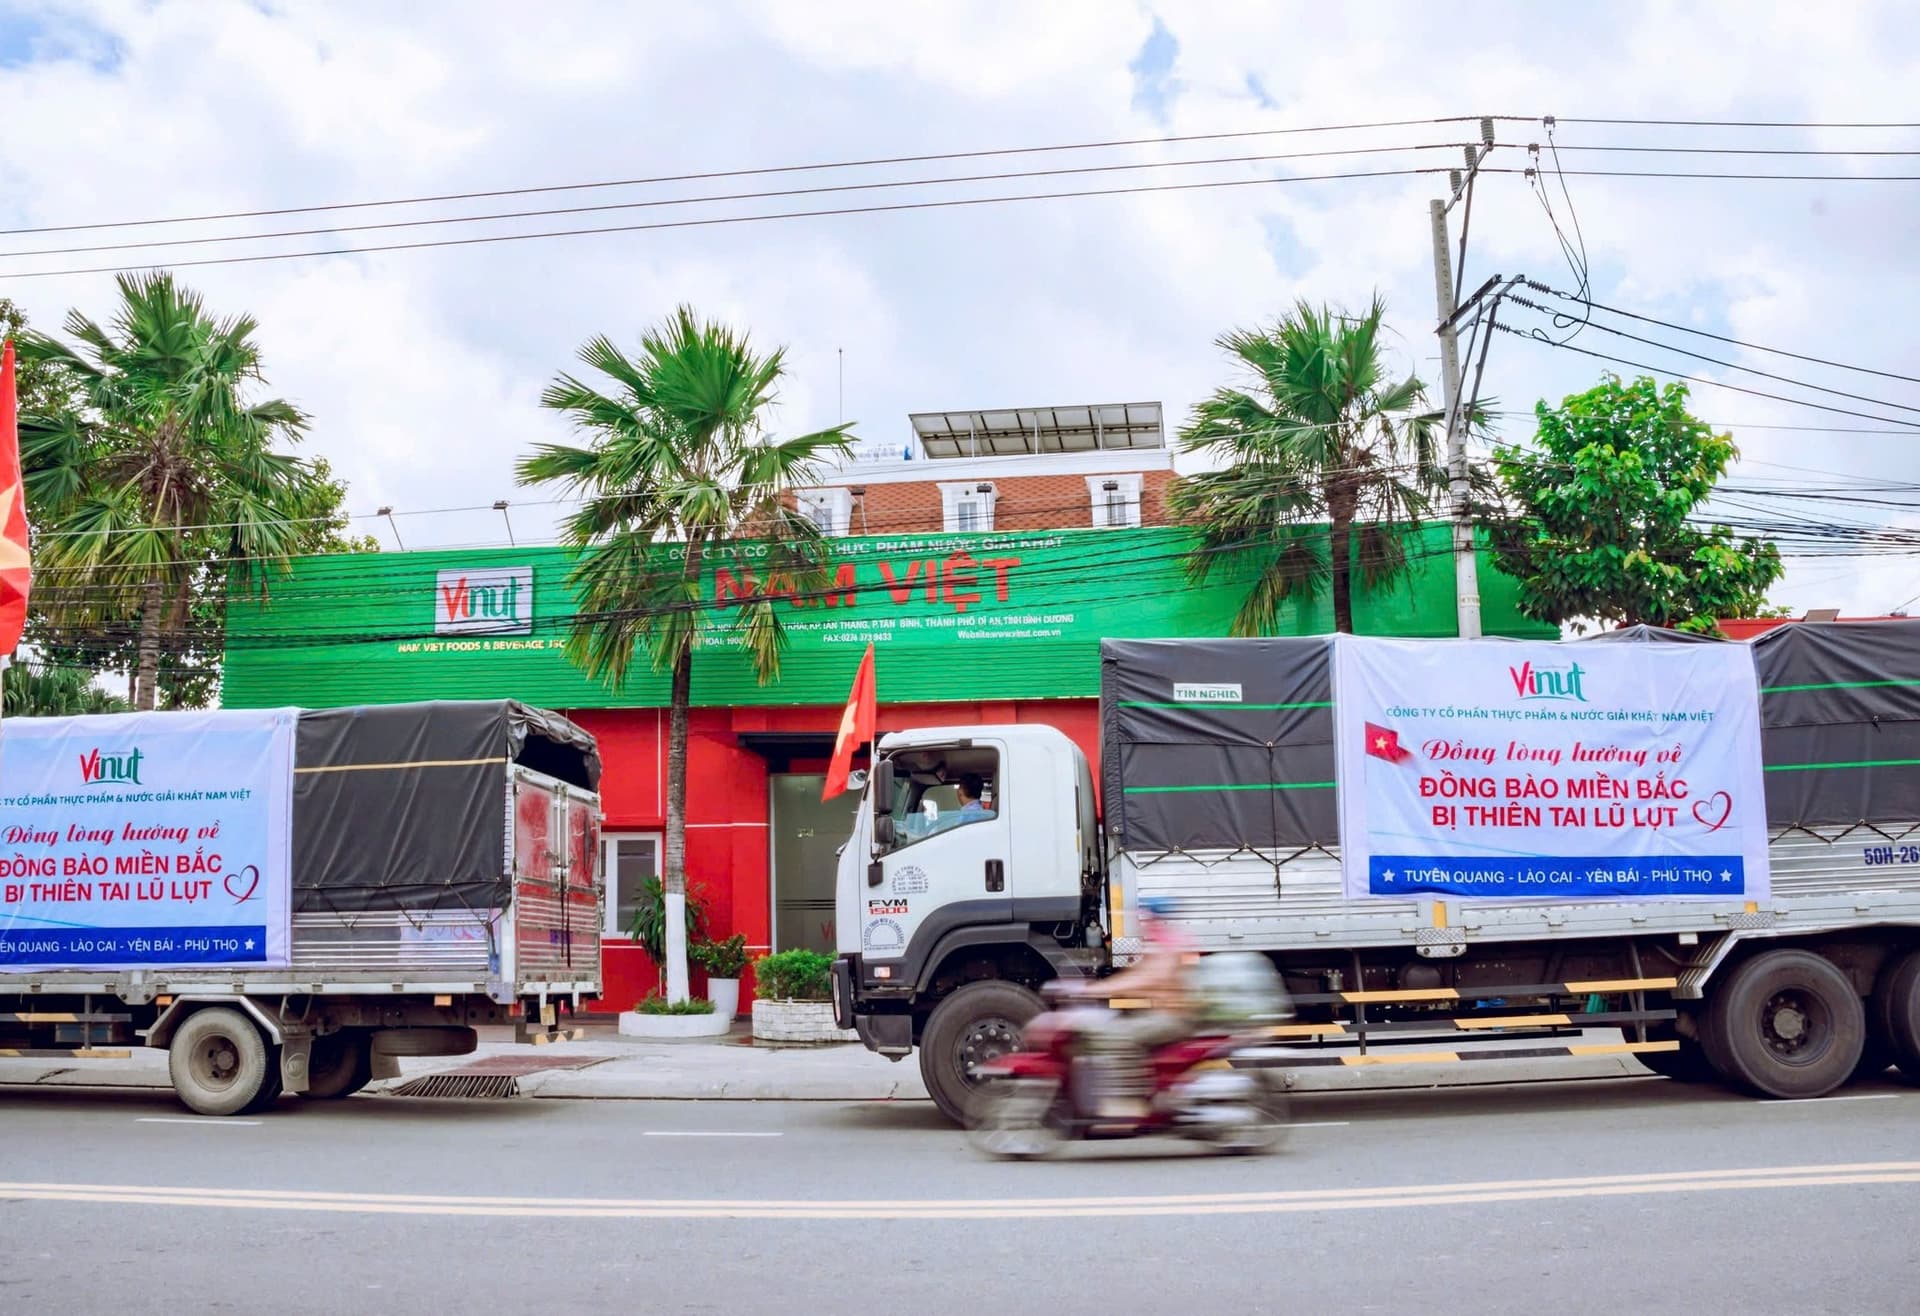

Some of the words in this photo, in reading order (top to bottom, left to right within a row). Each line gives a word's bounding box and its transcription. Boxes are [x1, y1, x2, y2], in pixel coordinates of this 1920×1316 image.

[878, 549, 1021, 613] VIỆT
[442, 576, 523, 626] Vinut
[447, 641, 481, 651] FOODS
[1509, 661, 1588, 701] Vinut
[1386, 705, 1419, 718] CÔNG
[1422, 707, 1436, 718] TY
[1560, 712, 1568, 721] &
[1662, 712, 1687, 722] NAM
[1689, 709, 1714, 723] VIỆT
[80, 747, 144, 785] Vinut
[1422, 739, 1497, 766] Đồng
[1506, 740, 1562, 767] lòng
[1571, 742, 1649, 768] hướng
[1656, 742, 1682, 764] về
[4, 797, 15, 806] TY
[116, 794, 123, 803] &
[126, 791, 154, 803] NƯỚC
[156, 789, 175, 801] GIẢI
[178, 790, 203, 801] KHÁT
[205, 790, 228, 801] NAM
[230, 788, 251, 801] VIỆT
[1419, 769, 1496, 798] ĐỒNG
[1505, 773, 1559, 799] BÀO
[1567, 771, 1629, 799] MIỀN
[1637, 771, 1688, 799] BẮC
[1432, 805, 1456, 830] BỊ
[1464, 801, 1541, 827] THIÊN
[1549, 807, 1585, 827] TAI
[1594, 803, 1625, 827] LŨ
[1633, 807, 1678, 831] LỤT
[1, 824, 59, 847] Đồng
[66, 823, 115, 846] lòng
[121, 821, 189, 844] hướng
[197, 819, 221, 840] về
[0, 852, 56, 877] ĐỒNG
[63, 852, 108, 876] BÀO
[116, 849, 169, 875] MIỀN
[176, 847, 222, 874] BẮC
[1864, 845, 1920, 866] 50H-26
[1404, 867, 1450, 883] TUYÊN
[1453, 870, 1505, 884] QUANG
[1518, 868, 1546, 883] LÀO
[1550, 871, 1572, 883] CAI
[1586, 868, 1613, 883] YÊN
[1617, 867, 1639, 882] BÁI
[1652, 867, 1680, 882] PHÚ
[1683, 870, 1713, 885] THỌ
[5, 884, 24, 905] BỊ
[30, 879, 92, 901] THIÊN
[99, 882, 129, 901] TAI
[137, 877, 164, 900] LŨ
[171, 881, 212, 904] LỤT
[868, 898, 908, 907] FVM
[18, 940, 60, 953] QUANG
[70, 938, 94, 952] LÀO
[96, 940, 117, 952] CAI
[127, 937, 151, 952] YÊN
[154, 937, 174, 952] BÁI
[184, 936, 210, 951] PHÚ
[212, 939, 239, 952] THỌ
